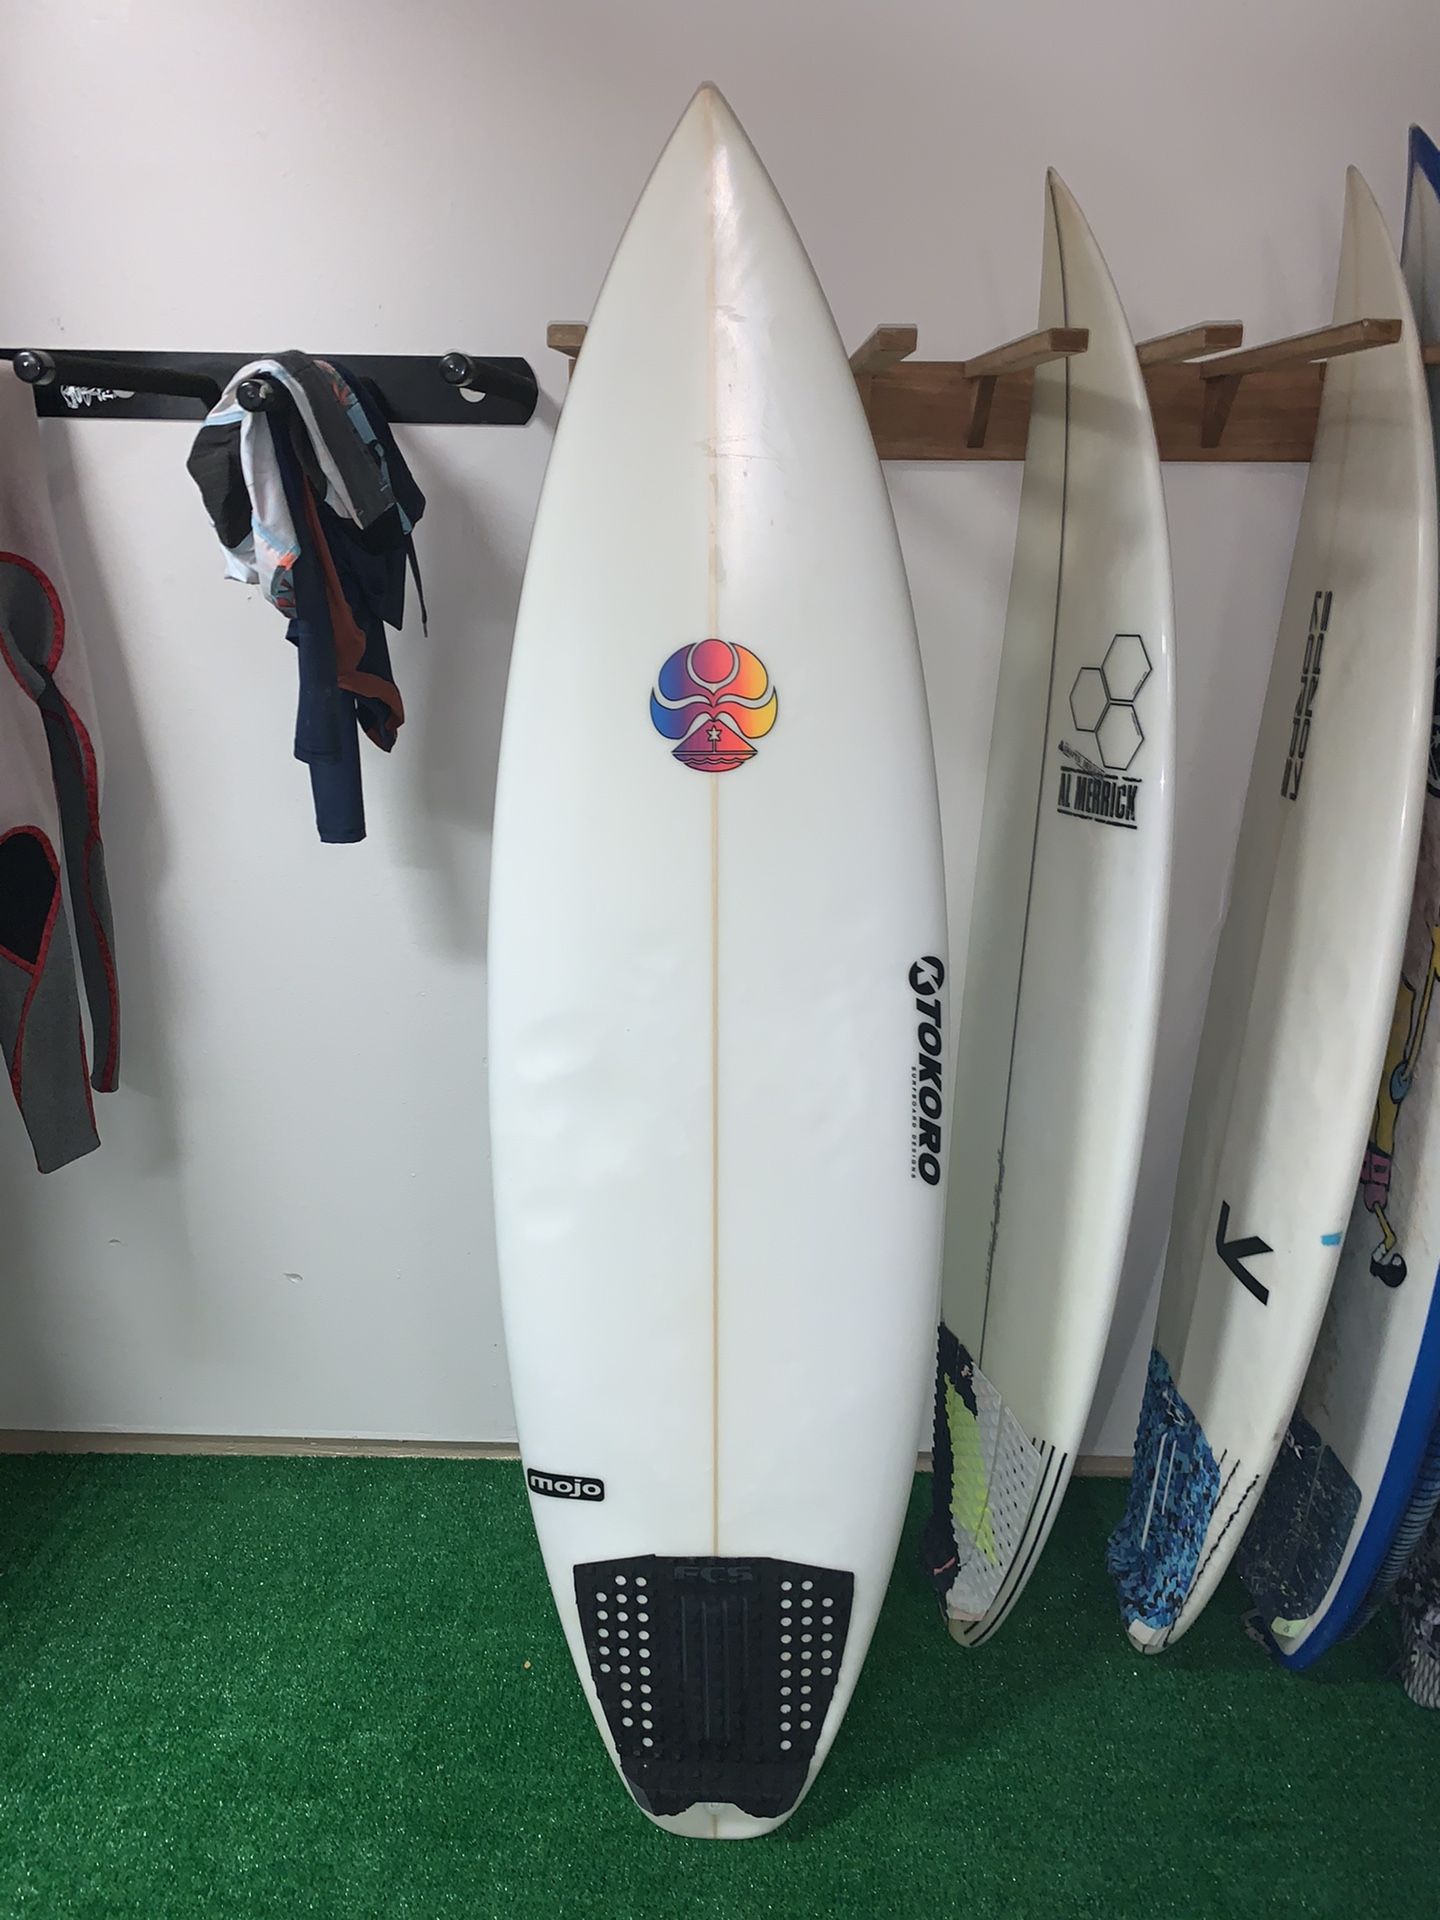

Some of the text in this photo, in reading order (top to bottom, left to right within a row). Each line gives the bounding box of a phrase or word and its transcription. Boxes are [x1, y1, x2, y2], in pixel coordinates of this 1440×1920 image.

[1058, 773, 1138, 821] AL MERRICK
[916, 998, 942, 1186] TOKORO
[530, 1475, 602, 1497] mojo
[673, 1566, 753, 1584] FCS
